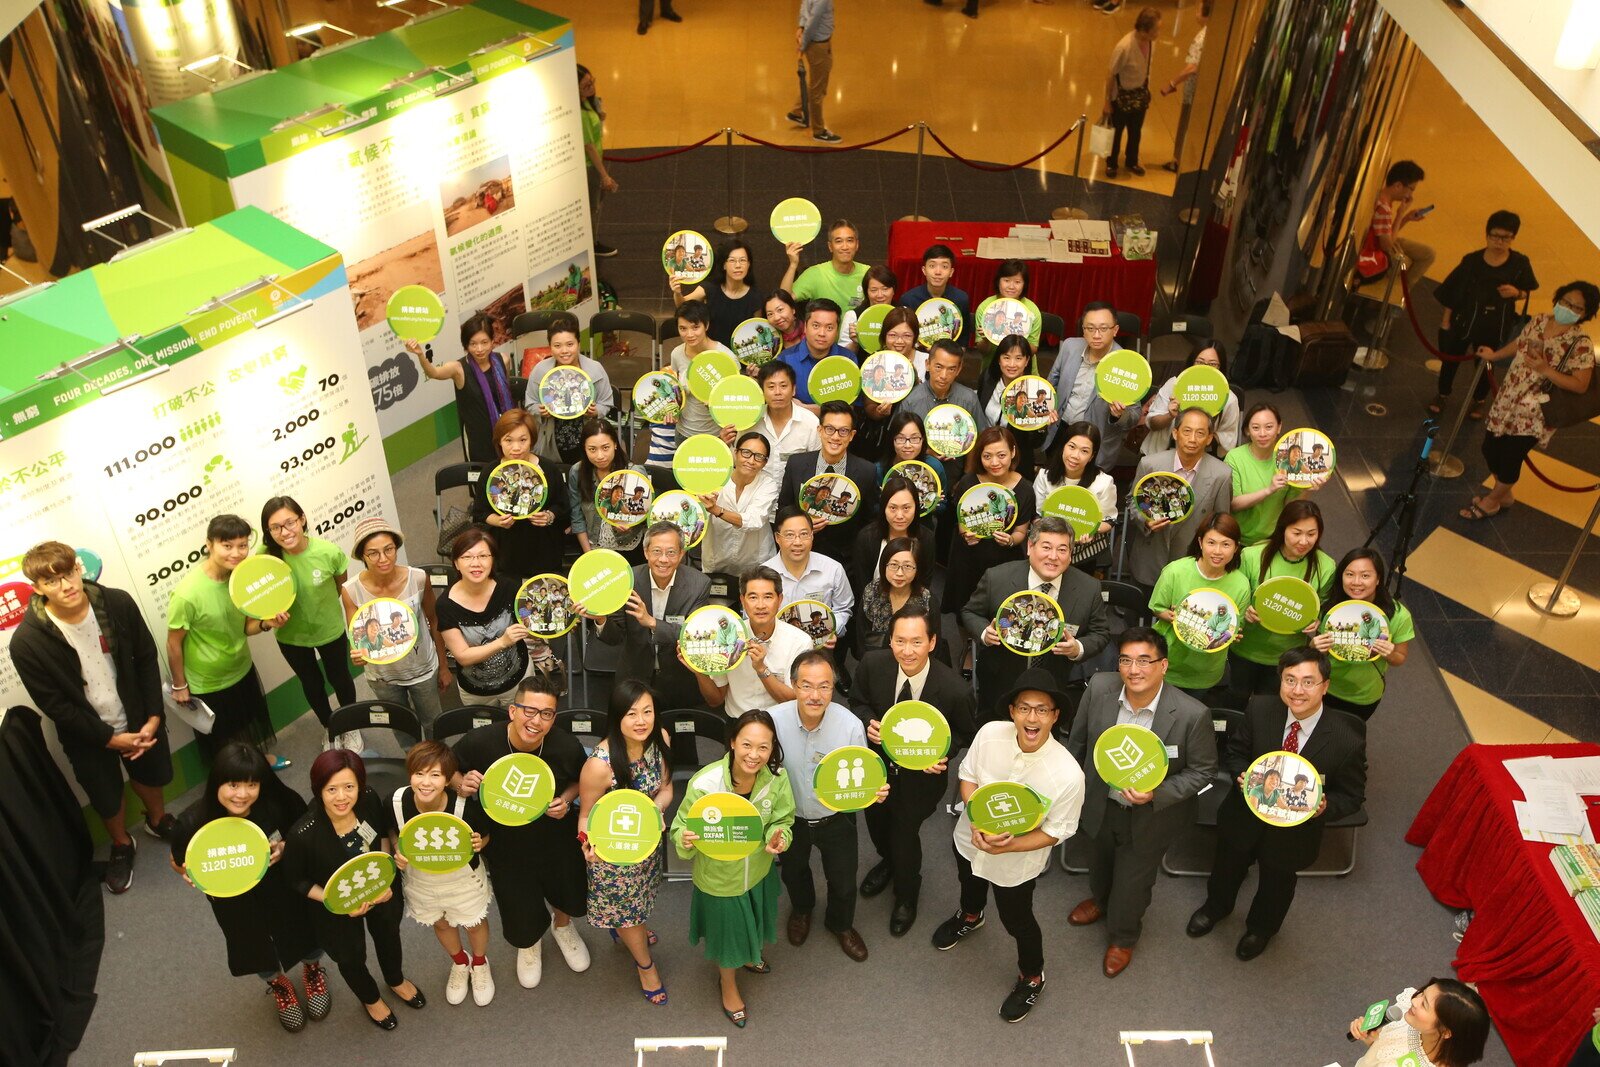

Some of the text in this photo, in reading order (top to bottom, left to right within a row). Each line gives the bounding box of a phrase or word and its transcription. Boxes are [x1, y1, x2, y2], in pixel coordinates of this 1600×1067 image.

[386, 97, 405, 111] FOUR
[476, 65, 489, 76] END
[489, 54, 517, 71] POVERTY
[53, 307, 259, 407] FOUR DECADES, ONE MISSION: END POVERTY
[318, 373, 340, 392] 70
[819, 381, 853, 397] 3120 5000
[1103, 373, 1140, 392] 3120 5000
[375, 383, 404, 409] 75倍
[1182, 392, 1219, 402] 3120 5000
[12, 404, 40, 426] 無窮
[272, 408, 320, 442] 2,000
[104, 435, 176, 478] 111,000
[280, 436, 336, 474] 93,000
[135, 485, 203, 527] 90,000
[1058, 503, 1087, 516] 捐款網站
[315, 499, 365, 536] 12,000
[147, 544, 210, 586] 300,00
[1261, 599, 1305, 624] 3120 5000
[1272, 592, 1303, 612] 捐款熱線
[1129, 761, 1156, 784] 公民教育
[494, 797, 526, 815] 公民教育
[207, 843, 248, 859] 捐款熱線
[607, 841, 639, 851] 人道救援
[201, 855, 256, 874] 3120 5000
